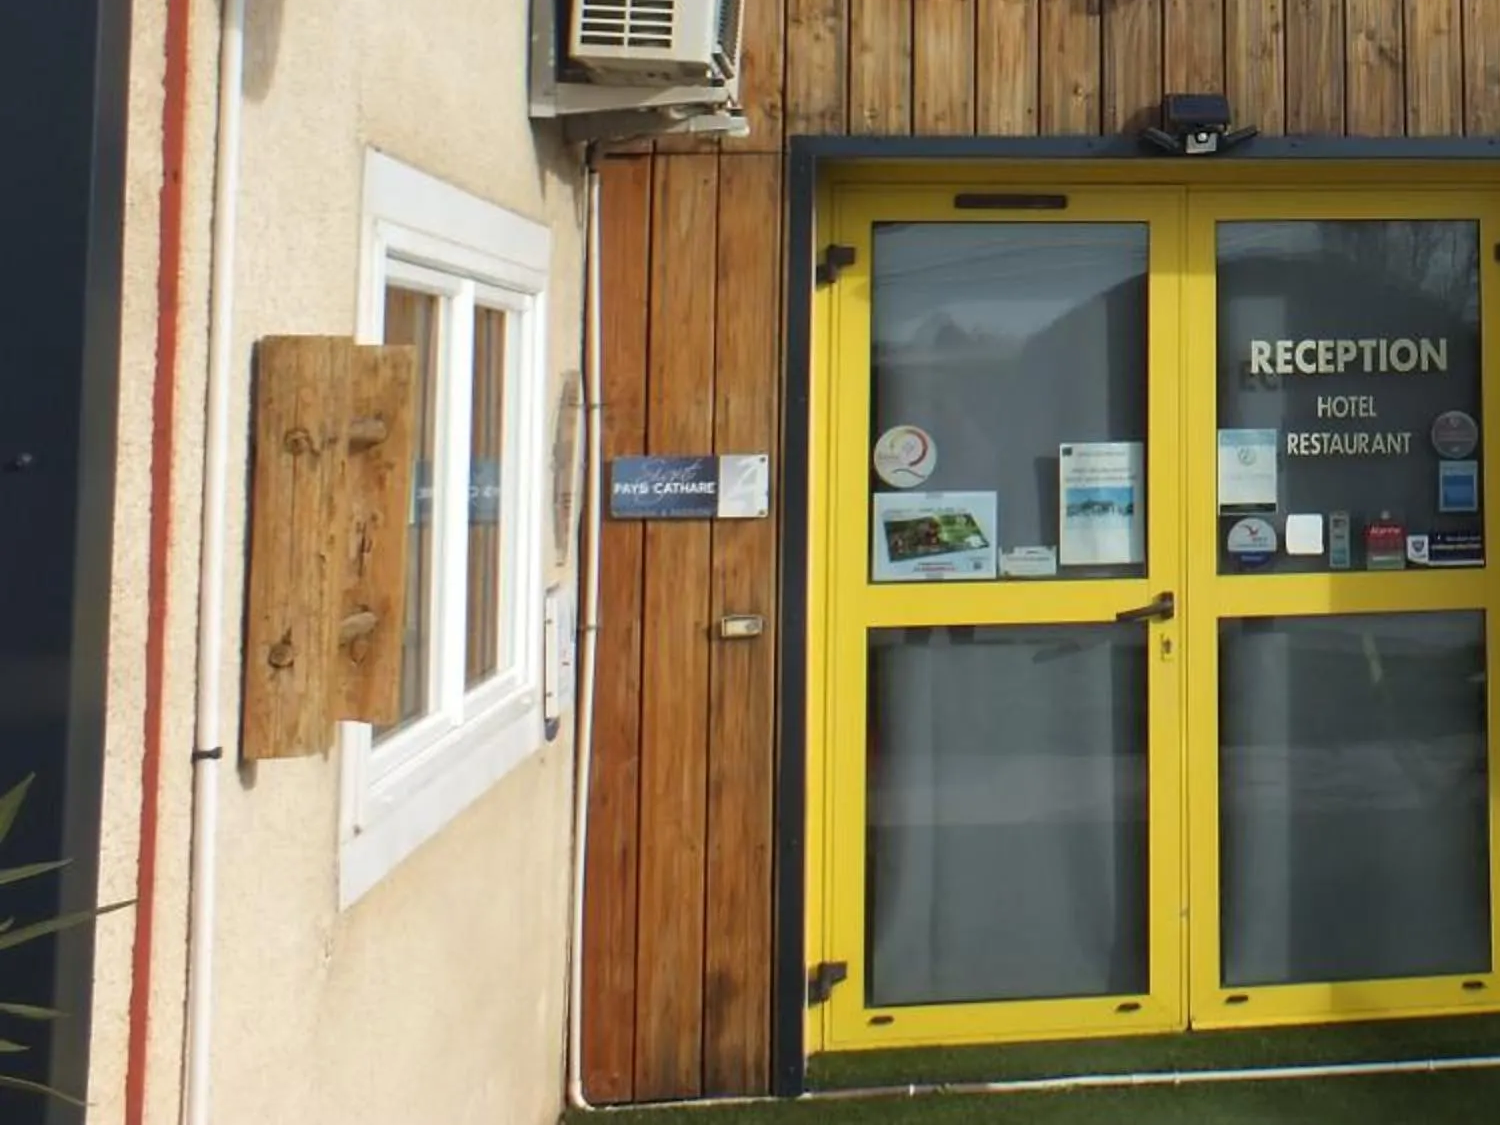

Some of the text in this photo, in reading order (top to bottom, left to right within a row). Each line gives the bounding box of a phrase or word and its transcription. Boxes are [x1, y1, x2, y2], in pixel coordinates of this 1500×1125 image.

[1250, 338, 1448, 375] RECEPTION
[1317, 395, 1377, 418] HOTEL
[1286, 431, 1412, 456] RESTAURANT
[613, 482, 716, 495] PAYS CATHARE
